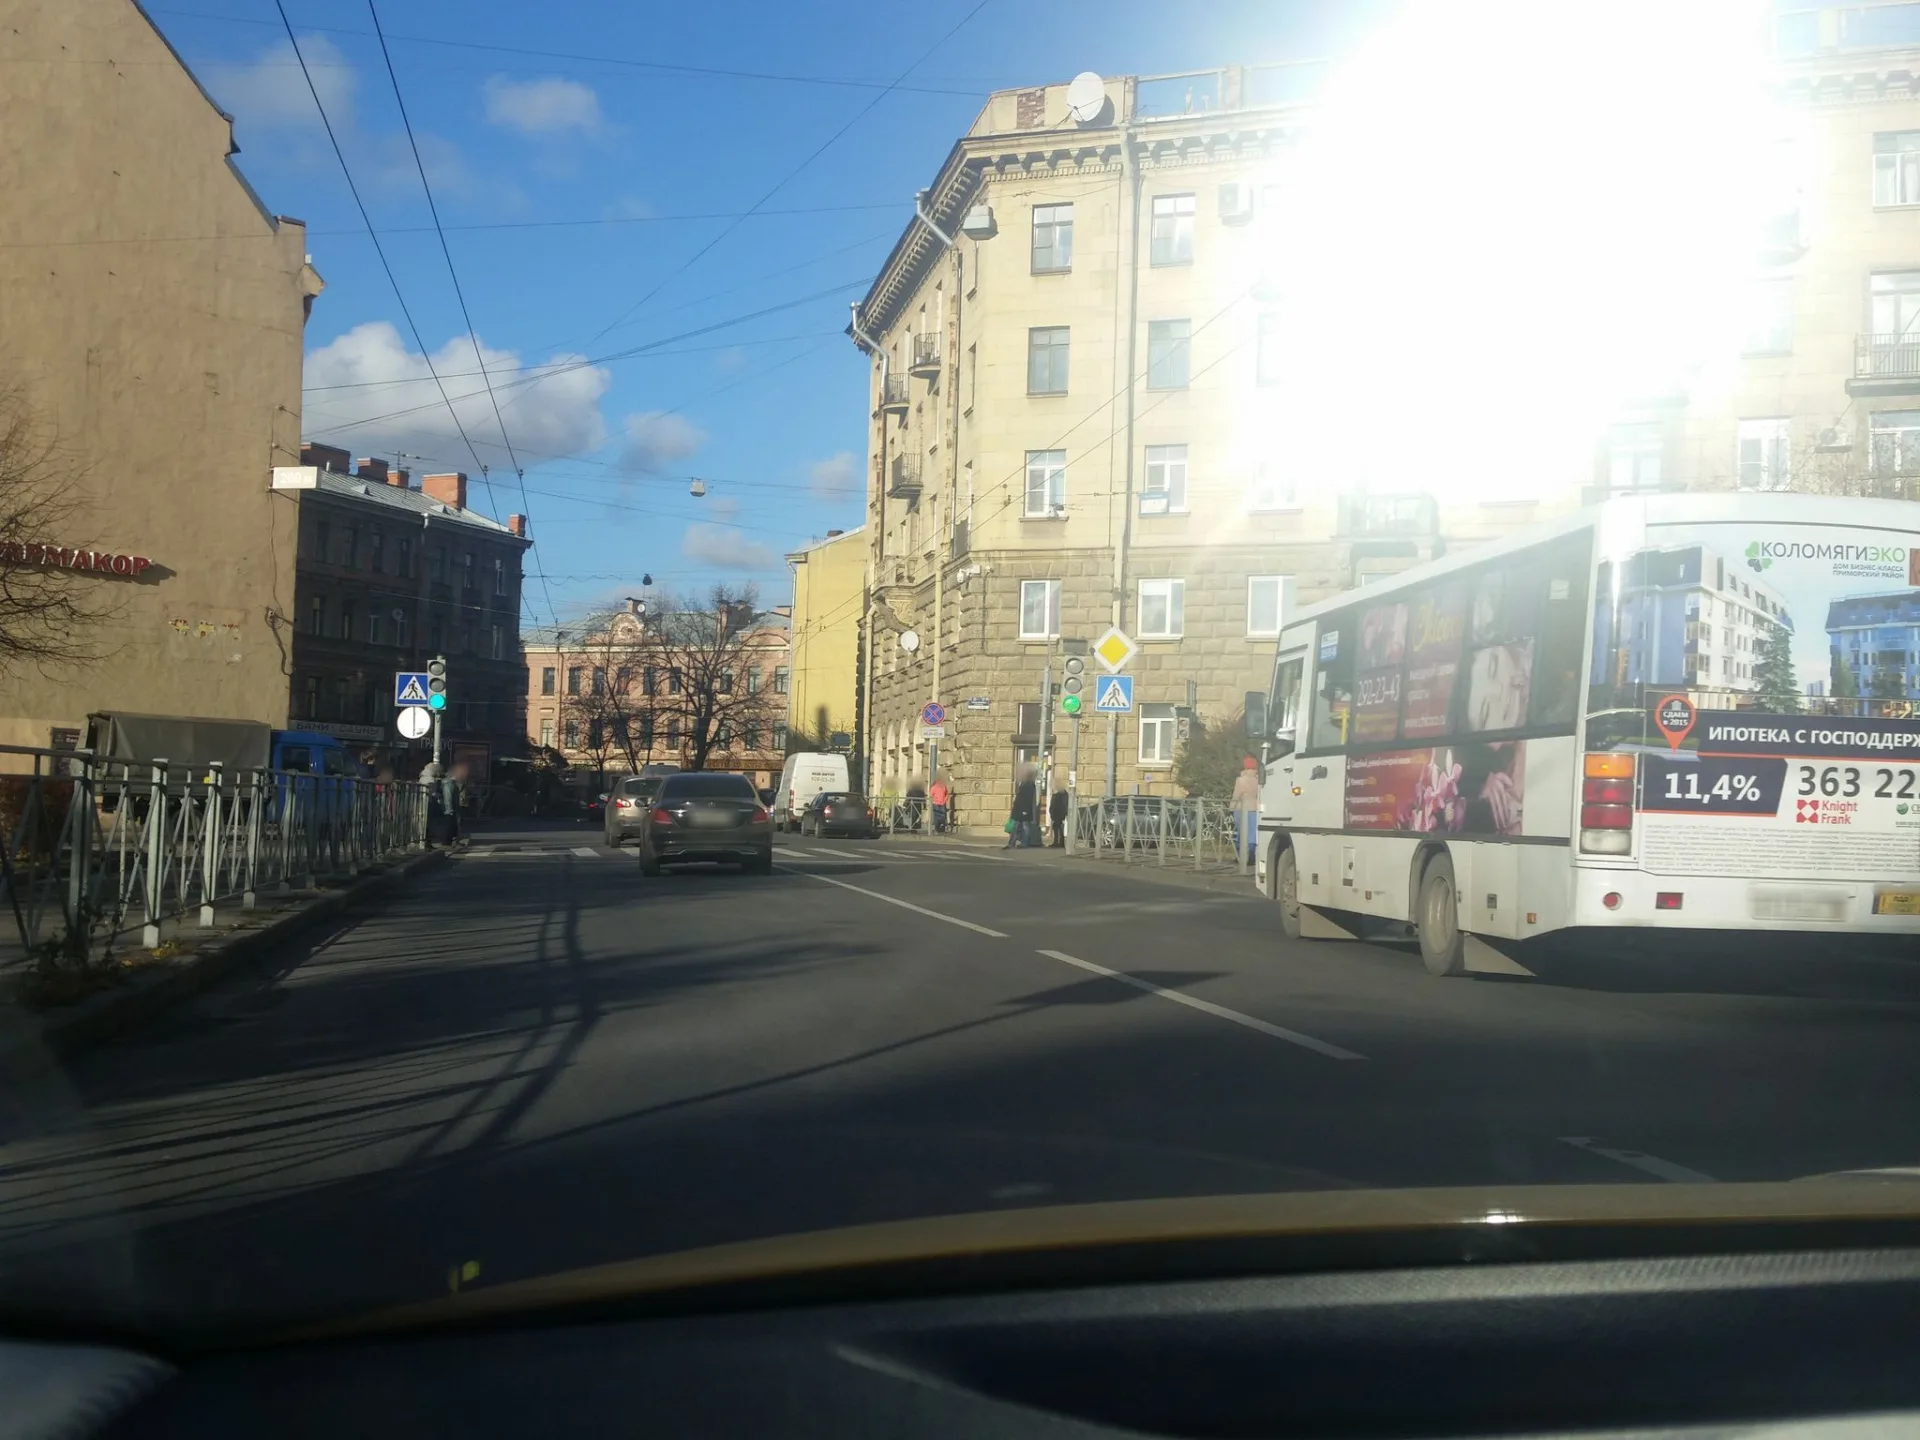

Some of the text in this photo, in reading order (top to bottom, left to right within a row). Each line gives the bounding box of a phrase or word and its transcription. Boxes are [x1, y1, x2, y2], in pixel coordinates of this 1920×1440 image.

[1761, 542, 1905, 562] КОЛОМЯГИЭКО
[1832, 570, 1880, 578] ПРИМОРСКИЙ
[1850, 564, 1904, 572] БИЗНЕС-КЛАССА
[1663, 711, 1688, 719] СДАЕМ
[1669, 718, 1688, 726] 2015
[1709, 726, 1790, 743] ИПОТЕКА
[1795, 729, 1806, 743] С
[1664, 772, 1761, 804] 11,4%
[1798, 766, 1920, 799] 363 22
[1821, 800, 1858, 815] Knight
[1821, 813, 1851, 825] Frank
